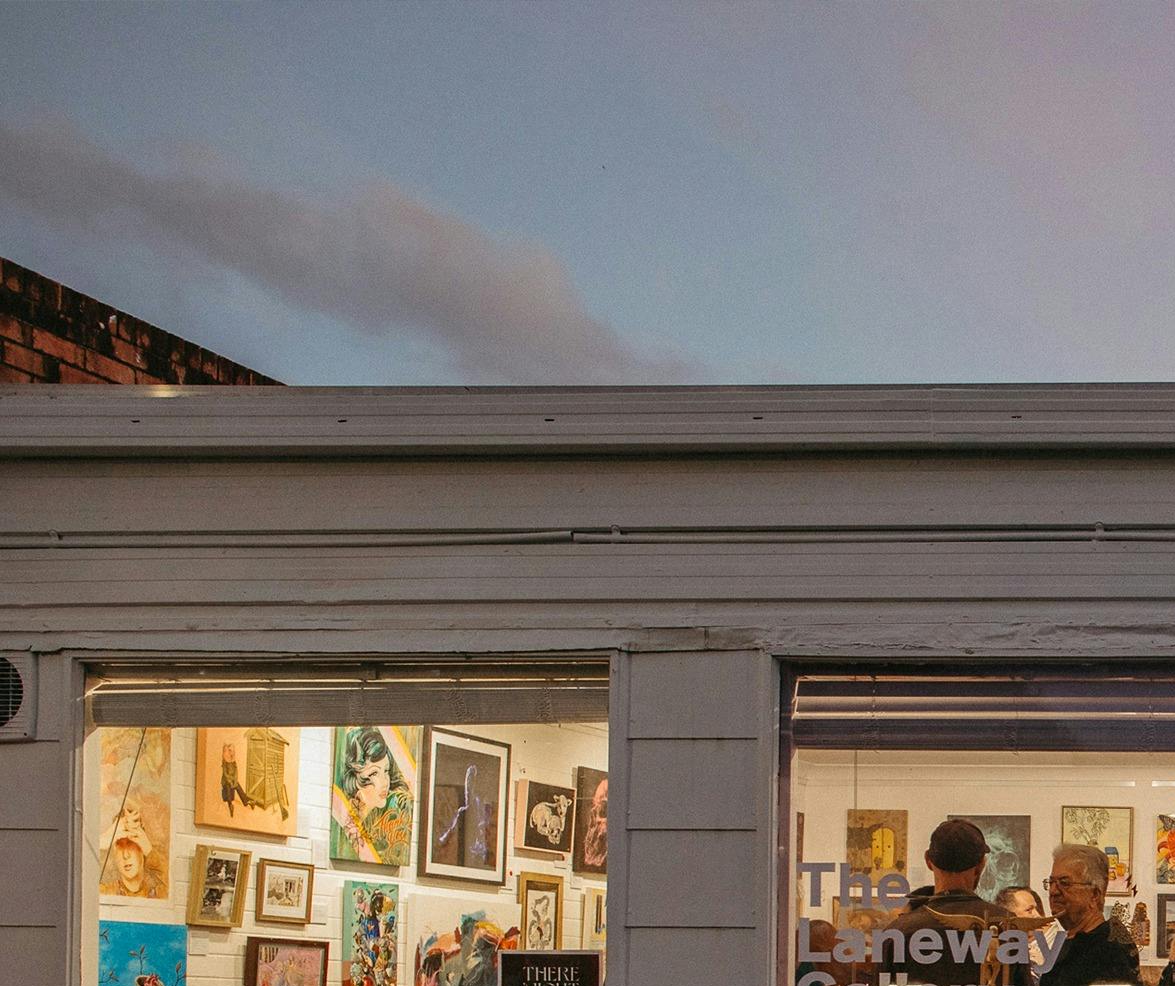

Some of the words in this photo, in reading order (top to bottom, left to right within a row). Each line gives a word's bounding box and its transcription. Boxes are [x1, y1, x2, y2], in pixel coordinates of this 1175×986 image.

[796, 863, 911, 909] The
[797, 917, 1067, 974] Laneway
[522, 966, 580, 981] THERE
